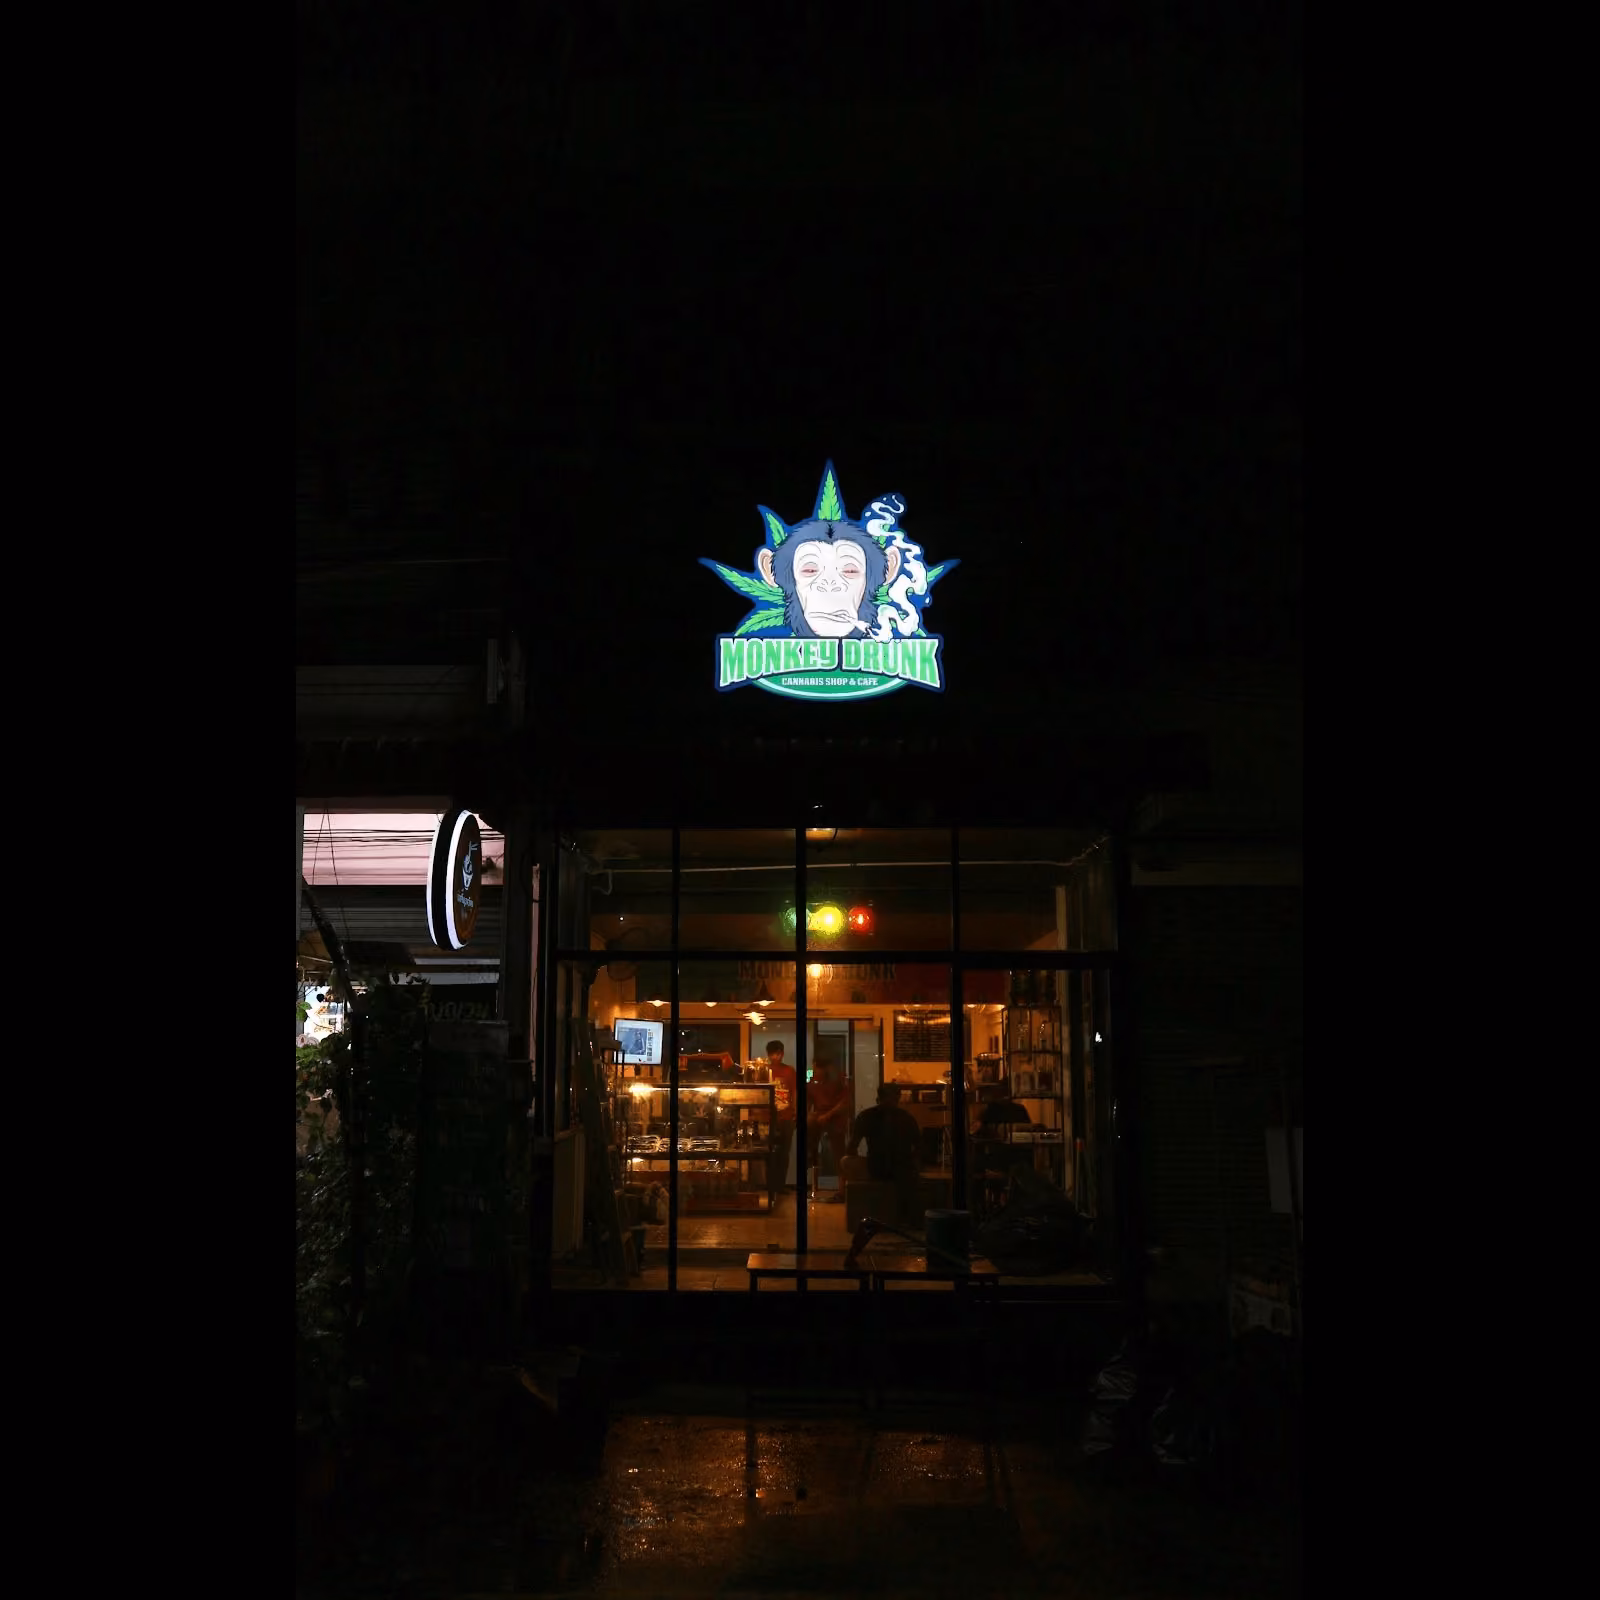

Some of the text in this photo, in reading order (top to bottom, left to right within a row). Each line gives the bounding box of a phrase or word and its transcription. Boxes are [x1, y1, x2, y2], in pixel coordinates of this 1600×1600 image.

[719, 637, 941, 688] MONKEY DRUNK
[781, 676, 879, 686] CANNABIS SHOP & CAFE
